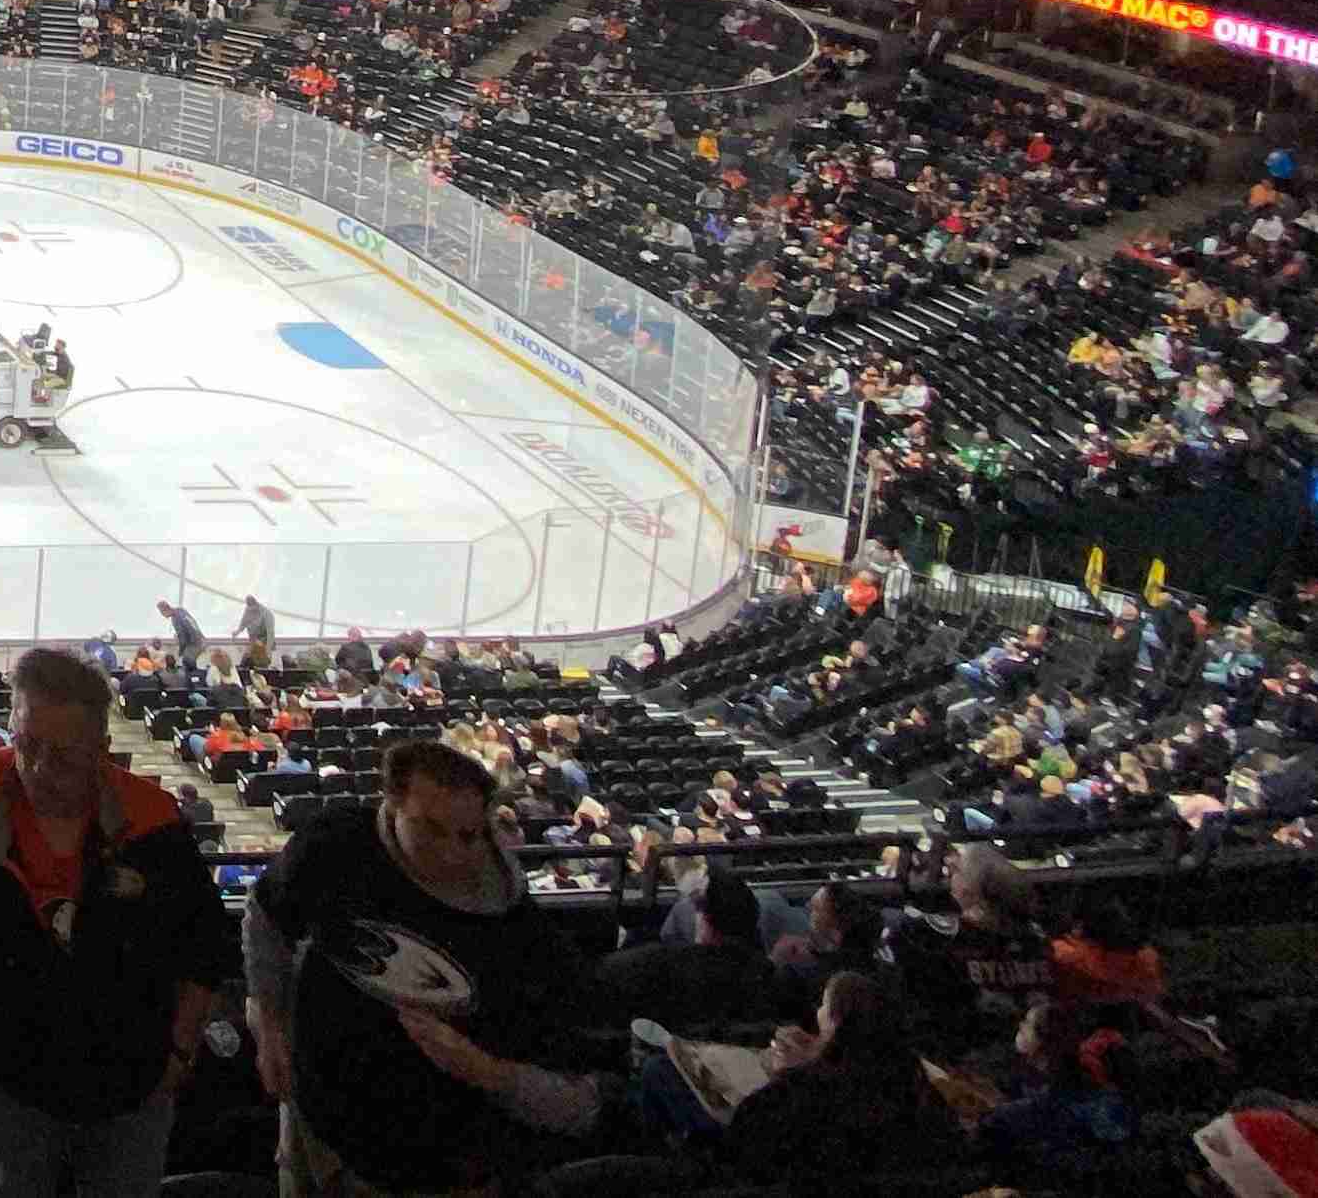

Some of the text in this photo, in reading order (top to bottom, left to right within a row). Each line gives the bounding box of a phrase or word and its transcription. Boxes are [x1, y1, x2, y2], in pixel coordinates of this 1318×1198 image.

[1213, 18, 1259, 48] ON
[16, 135, 124, 166] GEICO
[336, 216, 387, 259] COX
[512, 332, 587, 387] HONDA
